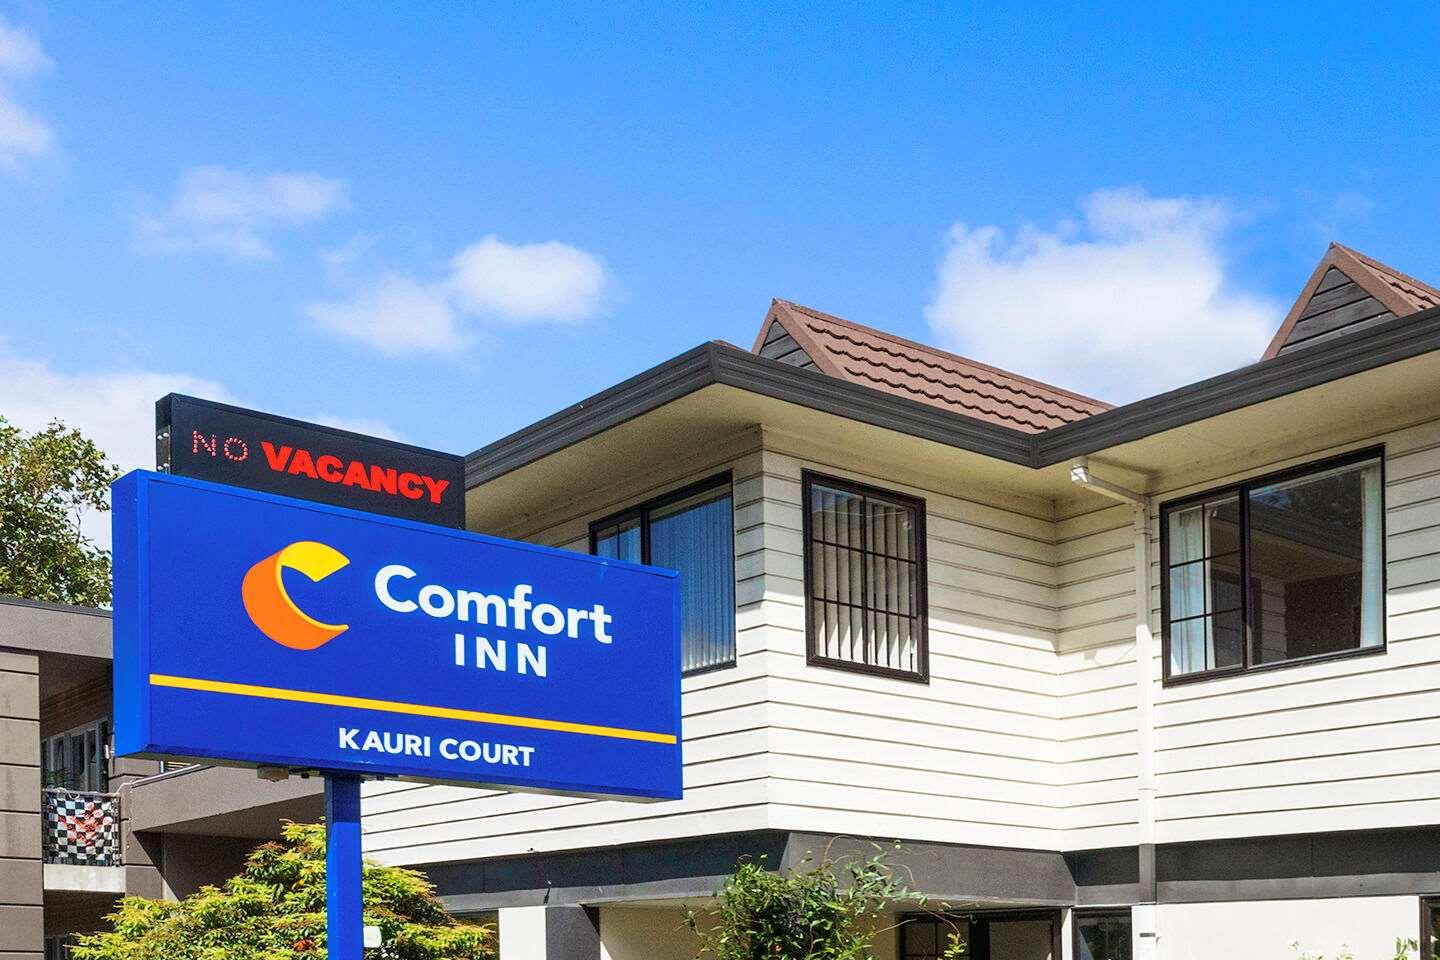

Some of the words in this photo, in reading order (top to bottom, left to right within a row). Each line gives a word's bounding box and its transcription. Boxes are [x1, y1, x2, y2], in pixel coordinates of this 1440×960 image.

[192, 430, 250, 463] NO
[261, 441, 450, 505] VACANCY
[374, 564, 613, 645] Comfort
[454, 633, 548, 678] INN
[338, 727, 431, 758] KAURI
[439, 737, 536, 767] COURT
